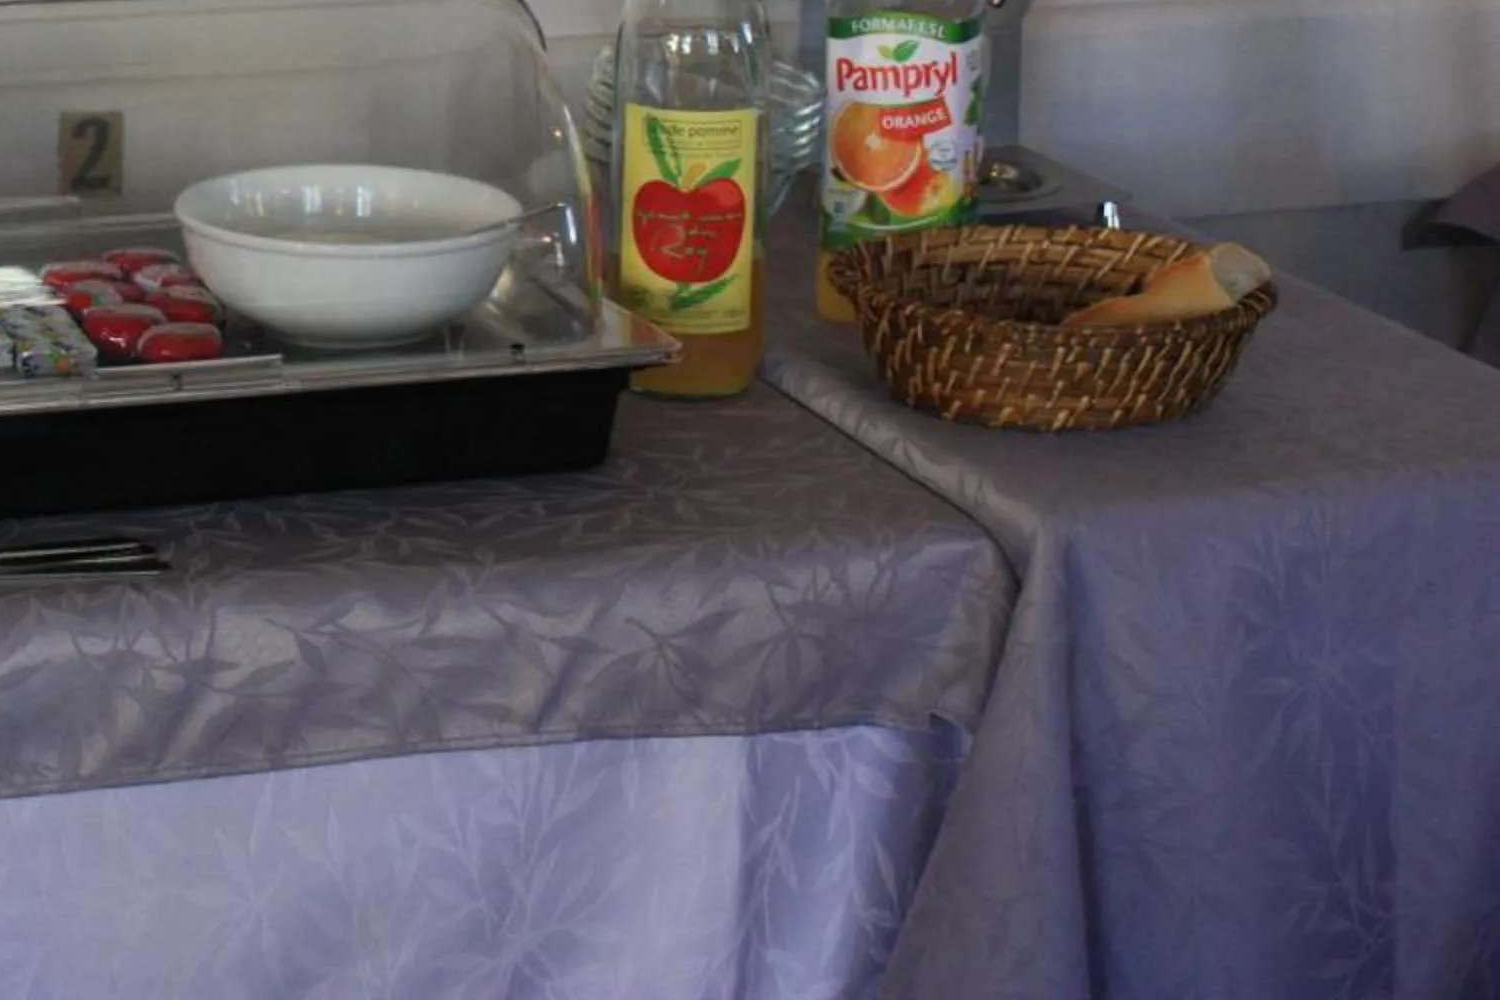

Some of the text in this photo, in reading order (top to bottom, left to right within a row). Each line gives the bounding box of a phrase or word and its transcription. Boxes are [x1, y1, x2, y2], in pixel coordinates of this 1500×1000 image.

[851, 17, 915, 34] FORMAT
[836, 53, 958, 97] Pampryl
[882, 110, 946, 129] ORANGE
[71, 117, 111, 189] 2
